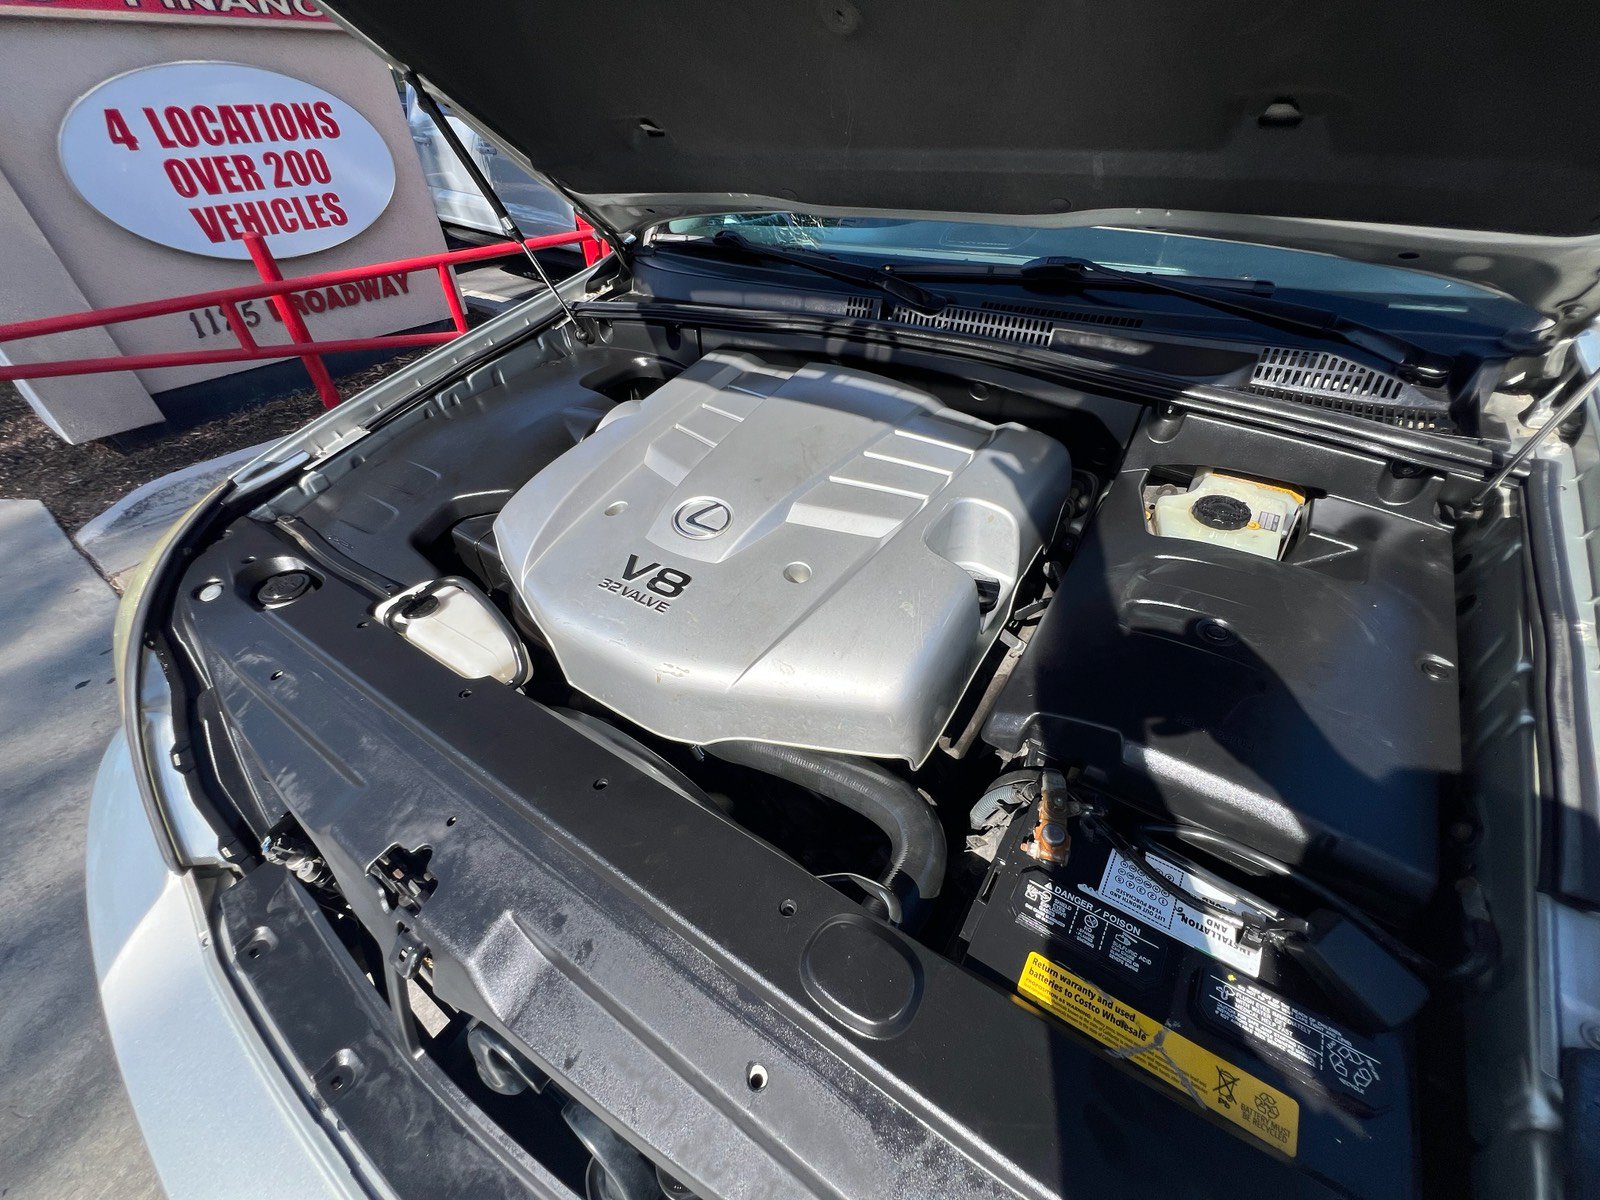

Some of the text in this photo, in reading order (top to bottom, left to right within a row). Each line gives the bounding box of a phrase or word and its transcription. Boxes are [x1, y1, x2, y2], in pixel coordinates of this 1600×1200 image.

[104, 101, 341, 151] 4 LOCATIONS
[163, 148, 332, 199] OVER 200
[189, 192, 348, 244] VEHICLES
[622, 554, 692, 598] V8
[1109, 890, 1122, 899] AND
[1115, 888, 1148, 907] PURCHASED
[1148, 905, 1162, 914] YEAR
[1054, 886, 1093, 911] DANGER
[1102, 911, 1141, 936] POISON
[1142, 907, 1154, 916] OUT
[1154, 913, 1166, 922] LIFT
[1206, 918, 1228, 933] AND
[1138, 955, 1153, 966] ACID
[1027, 967, 1063, 993] batteries
[1062, 988, 1073, 999] to
[1072, 994, 1102, 1015] Costco
[1100, 1009, 1148, 1042] Wholesale
[1031, 957, 1059, 979] Return
[1058, 974, 1097, 1001] warranty
[1096, 995, 1115, 1010] and
[1114, 1005, 1136, 1022] used
[1217, 1097, 1232, 1110] Pb
[1240, 1103, 1291, 1137] BATTERY MUST
[1242, 1112, 1289, 1144] BE RECYCLED
